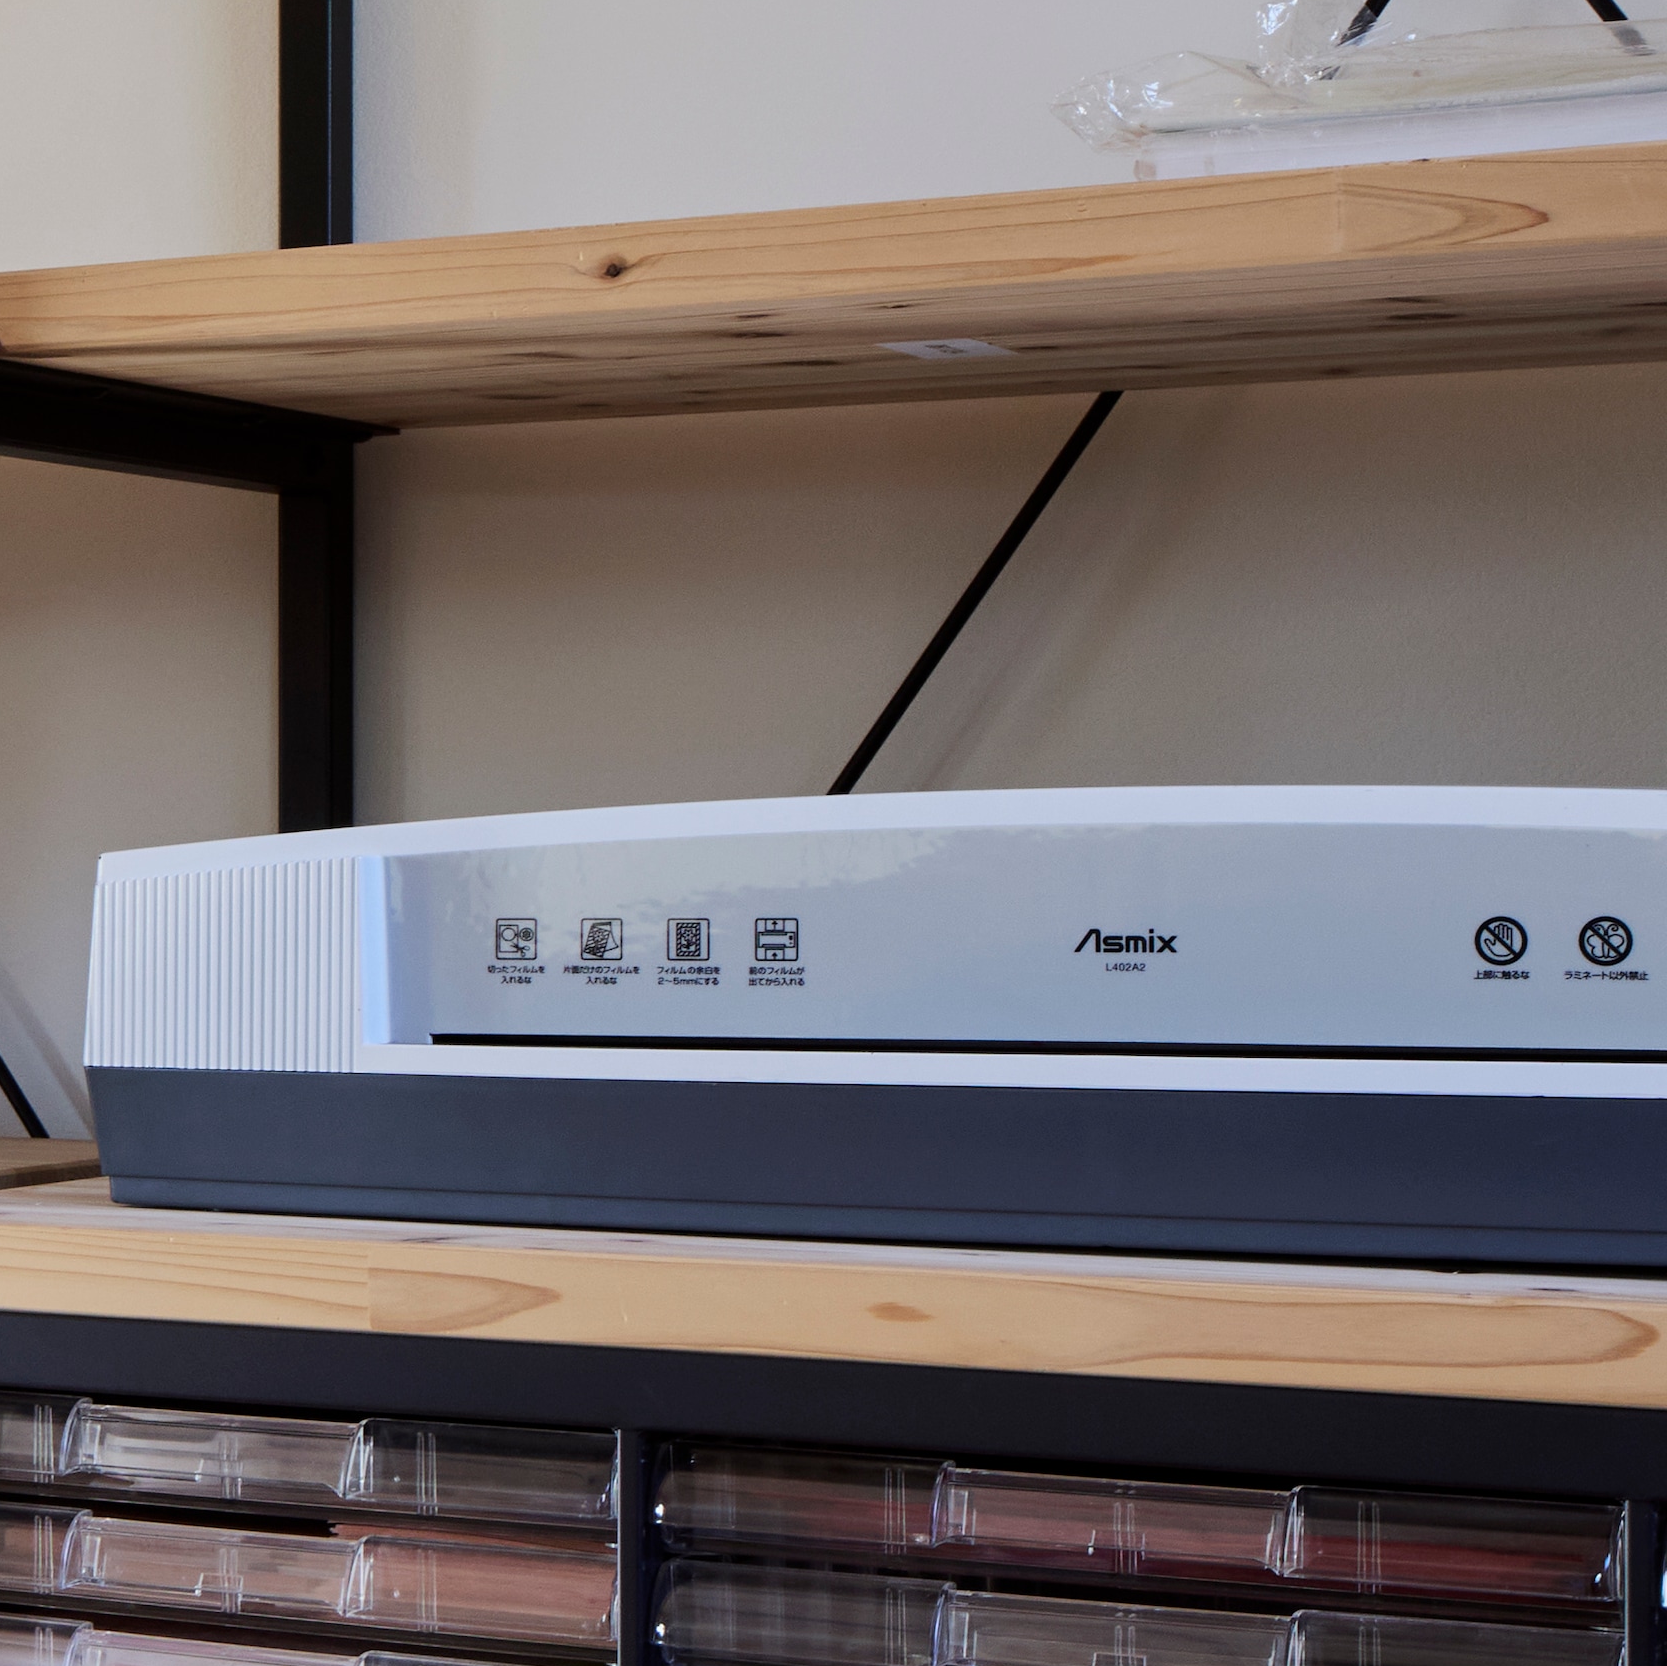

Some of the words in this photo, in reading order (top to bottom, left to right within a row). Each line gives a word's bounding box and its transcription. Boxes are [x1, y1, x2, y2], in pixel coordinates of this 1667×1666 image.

[1074, 928, 1177, 954] Asmix
[487, 965, 545, 975] 切ったフィルムを
[563, 965, 641, 975] 片面だけのフィルムを
[656, 966, 721, 976] フィルムの余白を
[1105, 963, 1146, 972] L402A2
[1474, 970, 1530, 980] 上部に触るな
[1564, 970, 1649, 981] ラミネート以外禁止
[501, 976, 532, 985] 入れるな
[586, 976, 618, 985] 入れるな
[748, 977, 805, 987] 出てから入れる
